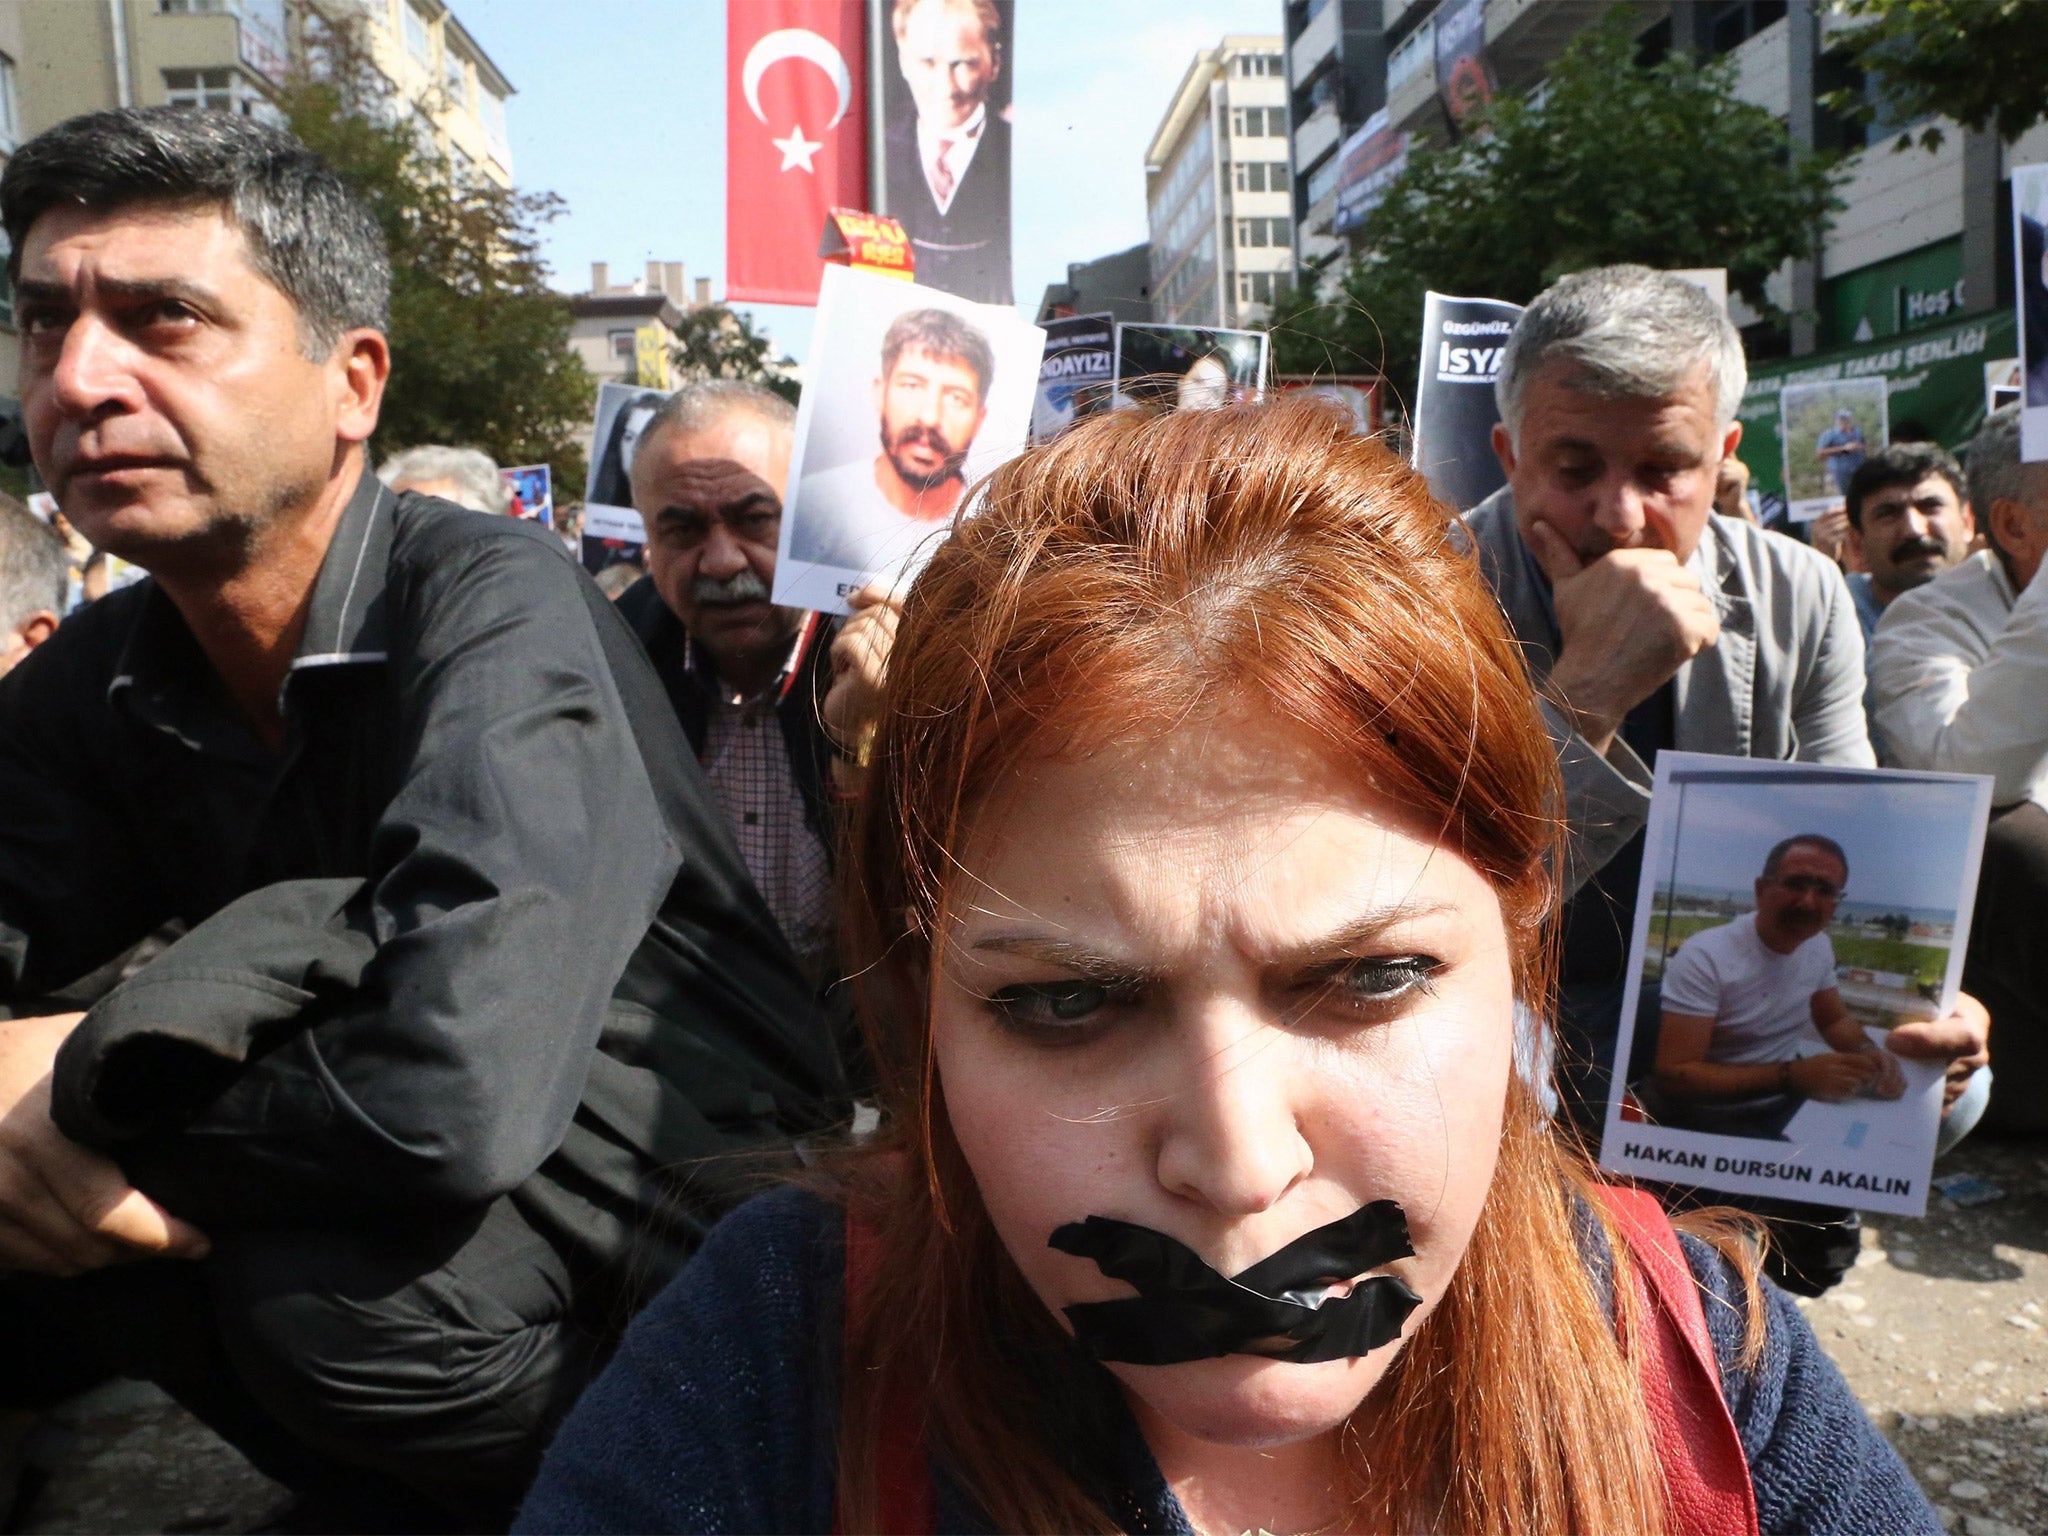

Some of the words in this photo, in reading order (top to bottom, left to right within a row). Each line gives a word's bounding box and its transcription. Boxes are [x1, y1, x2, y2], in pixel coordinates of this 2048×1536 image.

[1624, 1142, 1706, 1169] HAKAN
[1714, 1157, 1812, 1183] DURSUN
[1819, 1169, 1911, 1196] AKALIN
